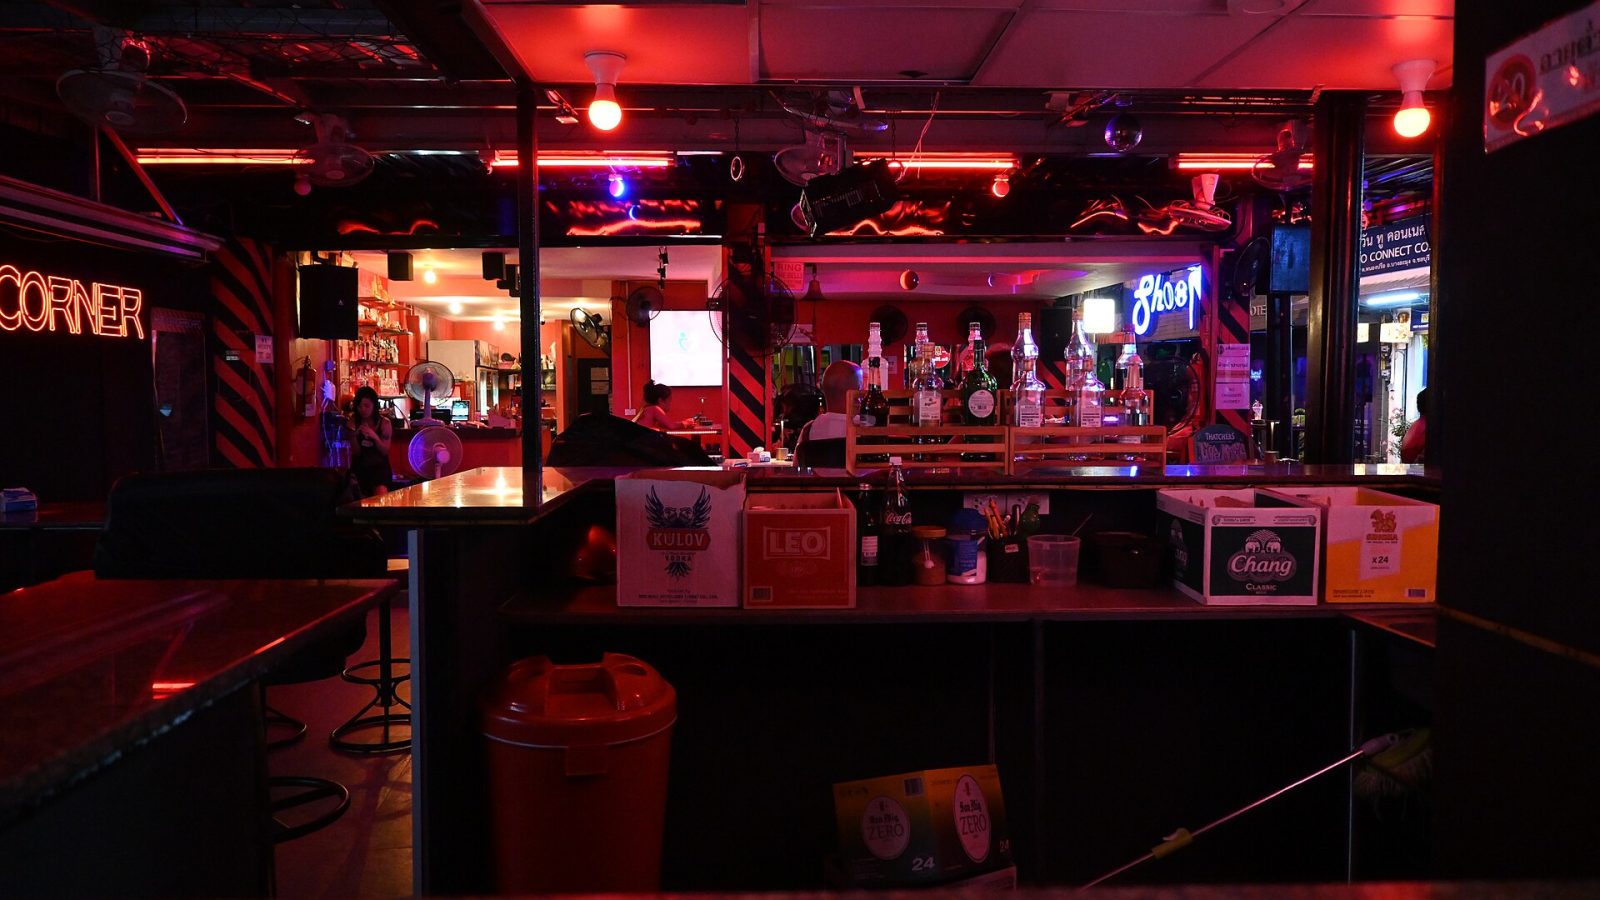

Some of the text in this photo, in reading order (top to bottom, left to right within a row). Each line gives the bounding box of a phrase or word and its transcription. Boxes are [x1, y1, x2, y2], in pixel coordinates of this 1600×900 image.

[1370, 245, 1412, 261] CONNECT
[0, 264, 144, 340] CORNER
[652, 532, 705, 547] KULOV
[769, 531, 826, 555] LEO
[1230, 553, 1293, 577] Chang
[867, 823, 905, 841] ZERO
[959, 813, 987, 836] ZERO
[911, 856, 936, 872] 24
